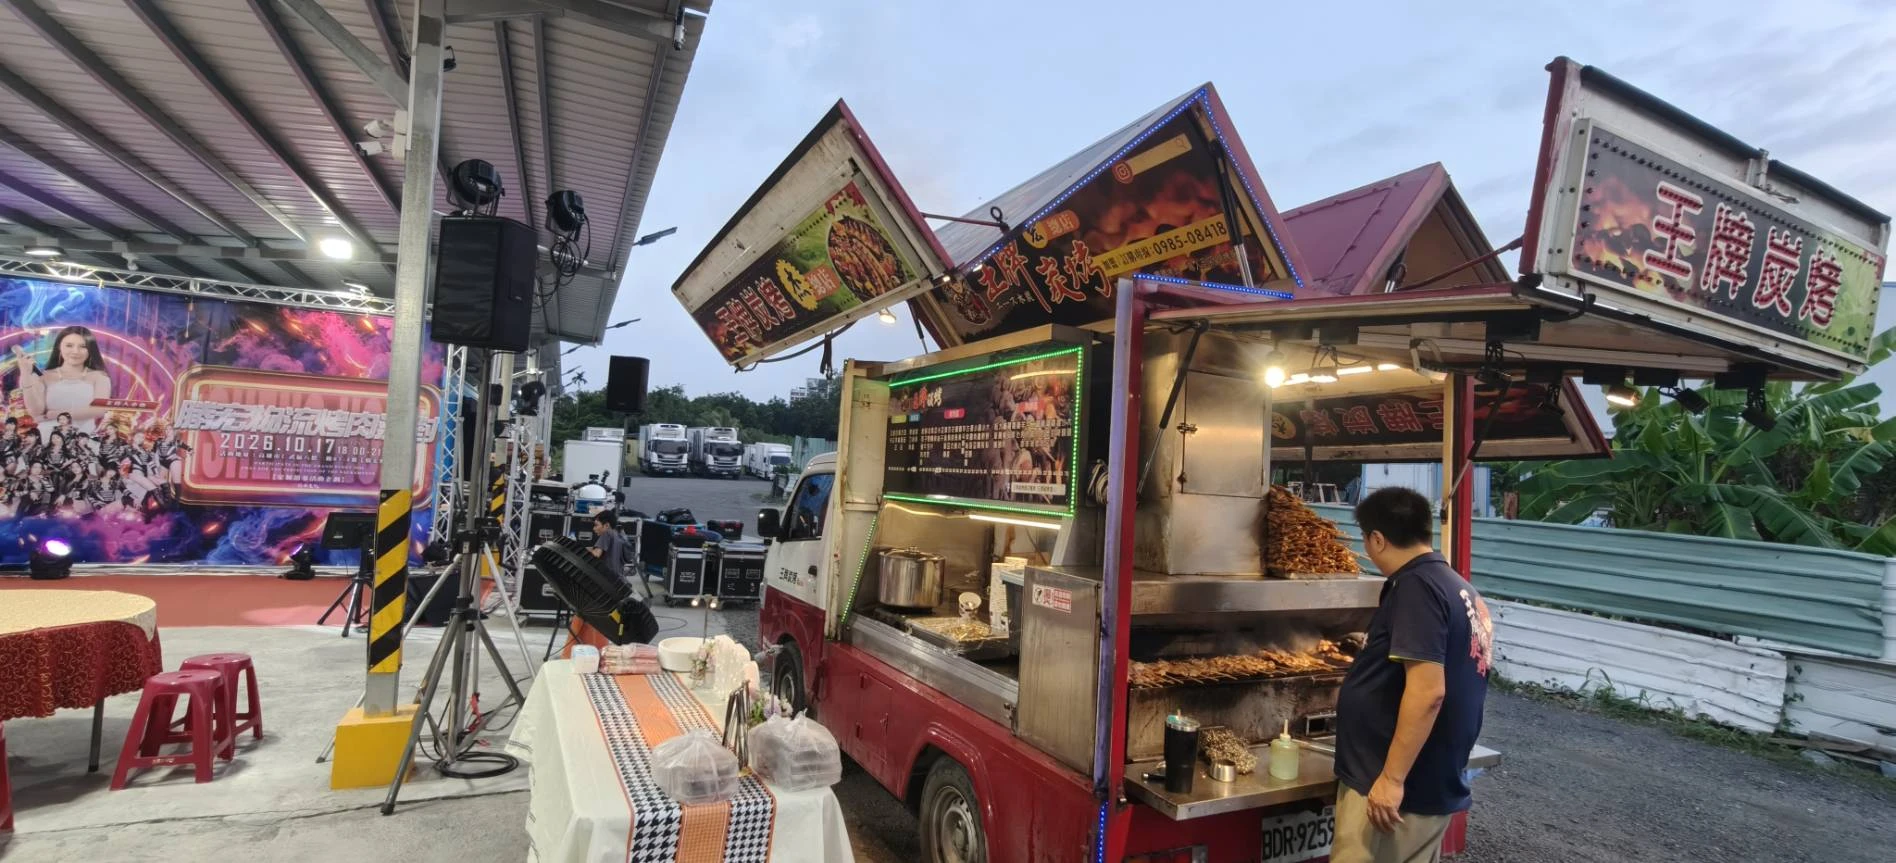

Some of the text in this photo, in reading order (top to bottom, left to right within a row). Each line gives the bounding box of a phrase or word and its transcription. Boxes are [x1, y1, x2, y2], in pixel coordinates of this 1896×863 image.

[977, 239, 1111, 313] 王牌炭烤
[1643, 180, 1843, 331] 王牌炭烤
[714, 275, 796, 344] 王牌炭烤
[220, 433, 335, 454] 2026.10.17
[1262, 816, 1336, 860] BDR-9259
